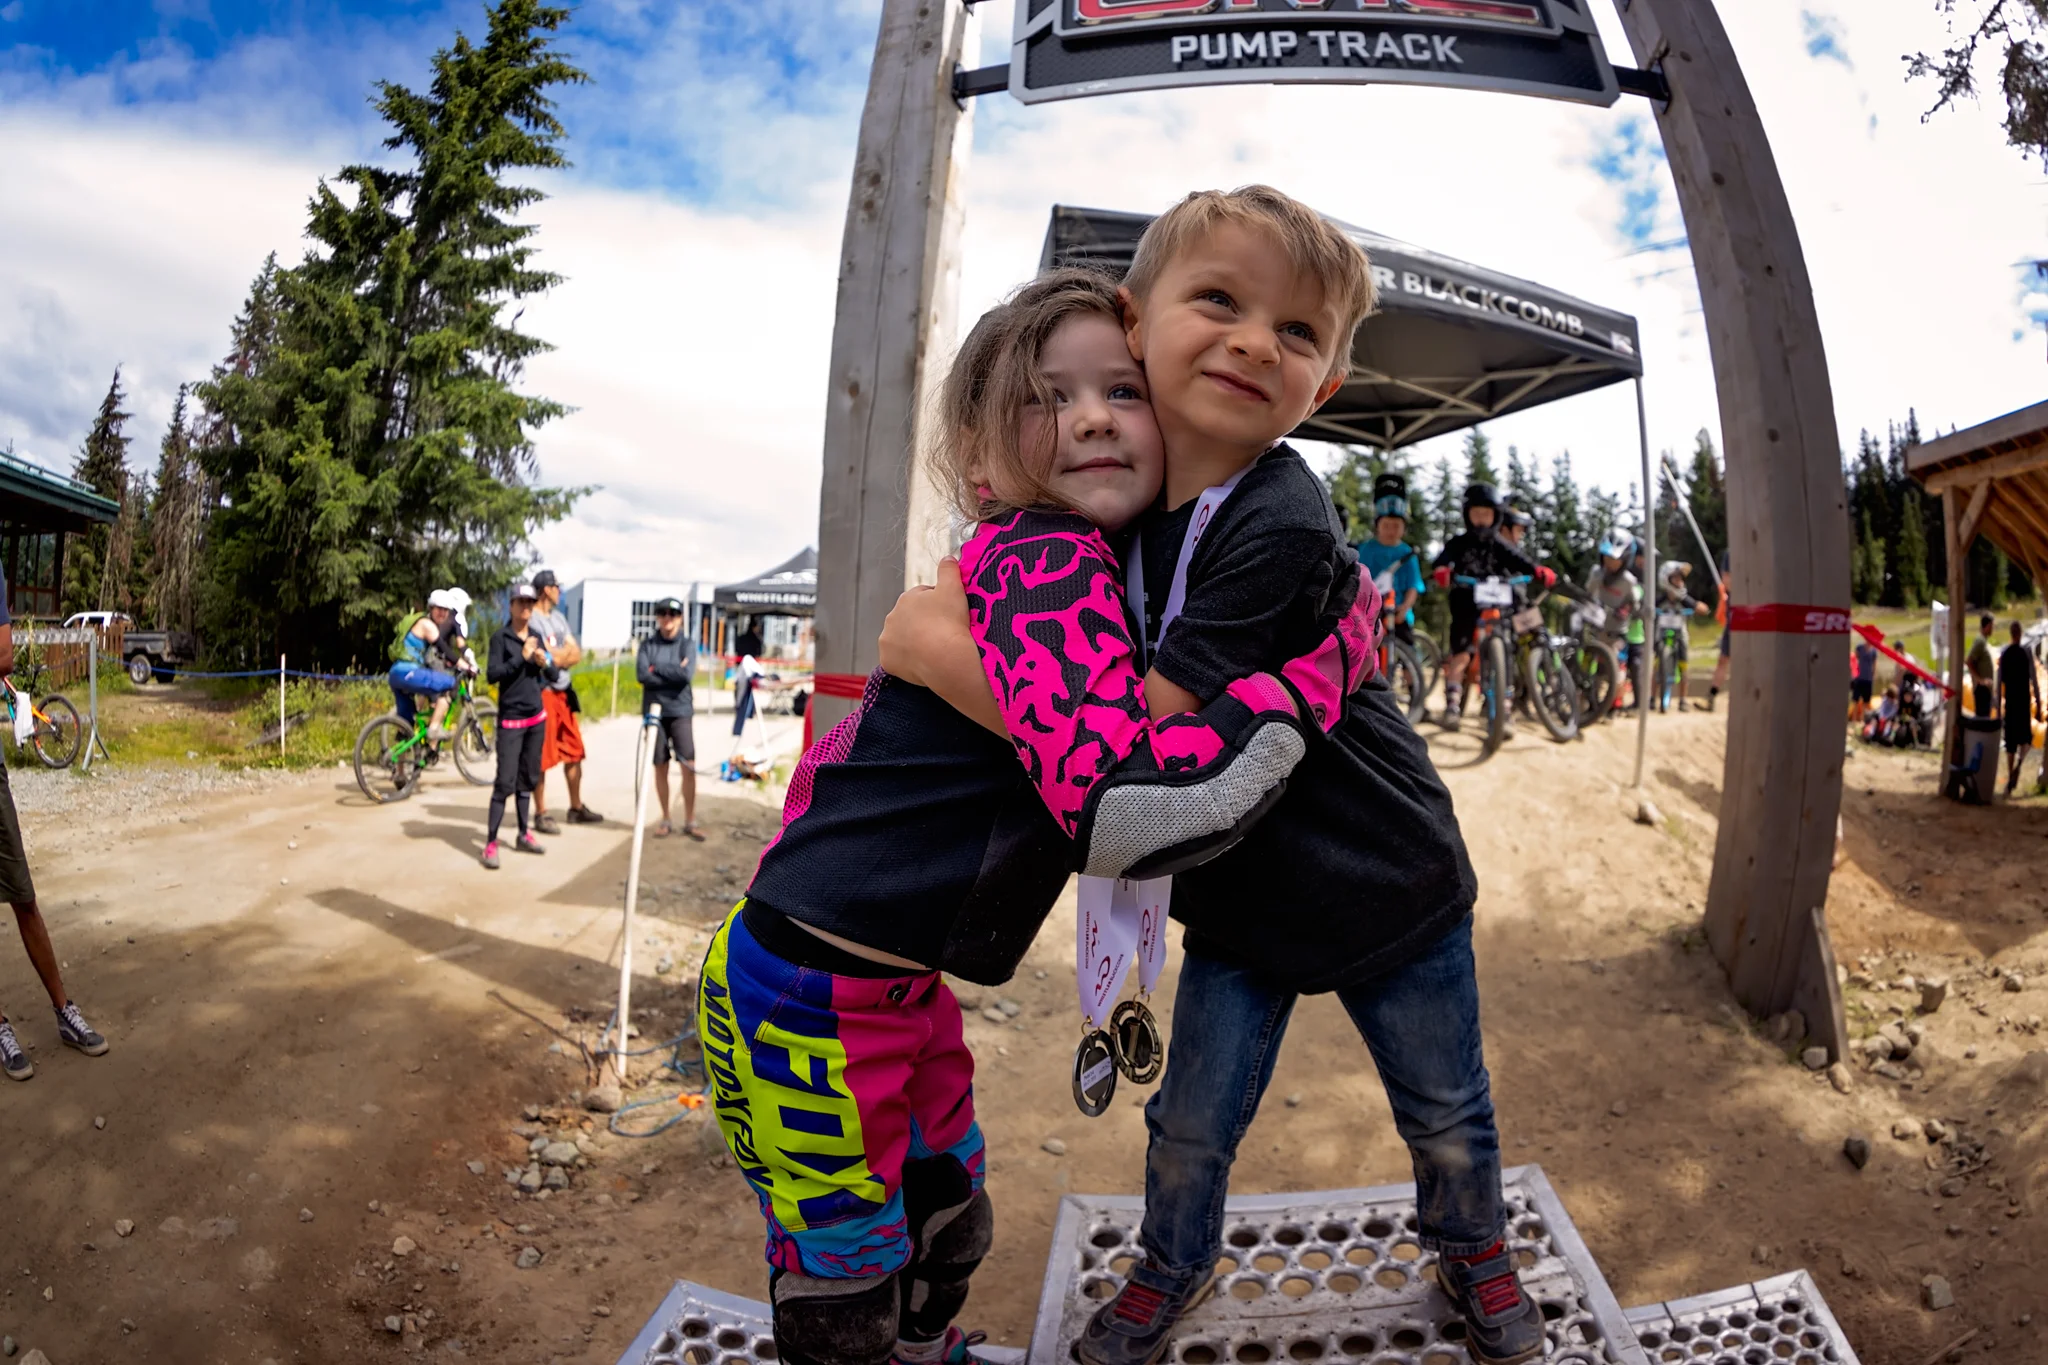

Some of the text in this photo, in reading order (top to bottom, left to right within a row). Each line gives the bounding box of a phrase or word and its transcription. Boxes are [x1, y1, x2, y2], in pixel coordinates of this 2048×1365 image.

[1171, 30, 1463, 63] PUMP TRACK
[1402, 271, 1585, 337] BLACKCOMB
[753, 1020, 887, 1233] FOX
